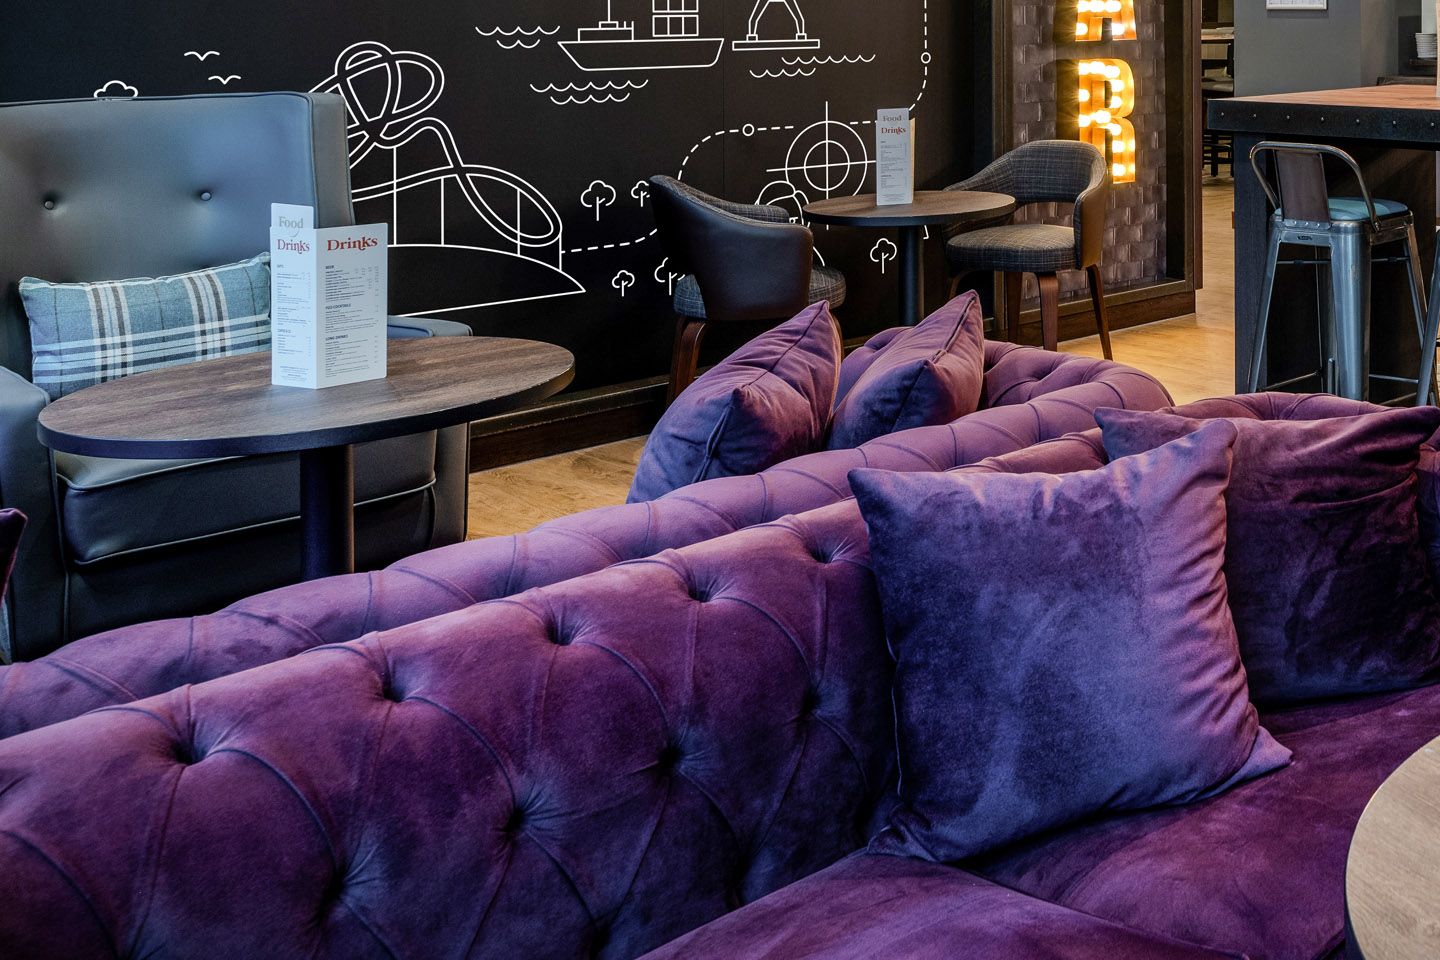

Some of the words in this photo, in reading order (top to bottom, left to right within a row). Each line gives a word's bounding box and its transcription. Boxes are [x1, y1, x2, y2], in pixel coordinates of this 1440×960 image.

[279, 216, 304, 228] Food
[277, 239, 310, 254] Drinks
[327, 236, 378, 251] Drinks
